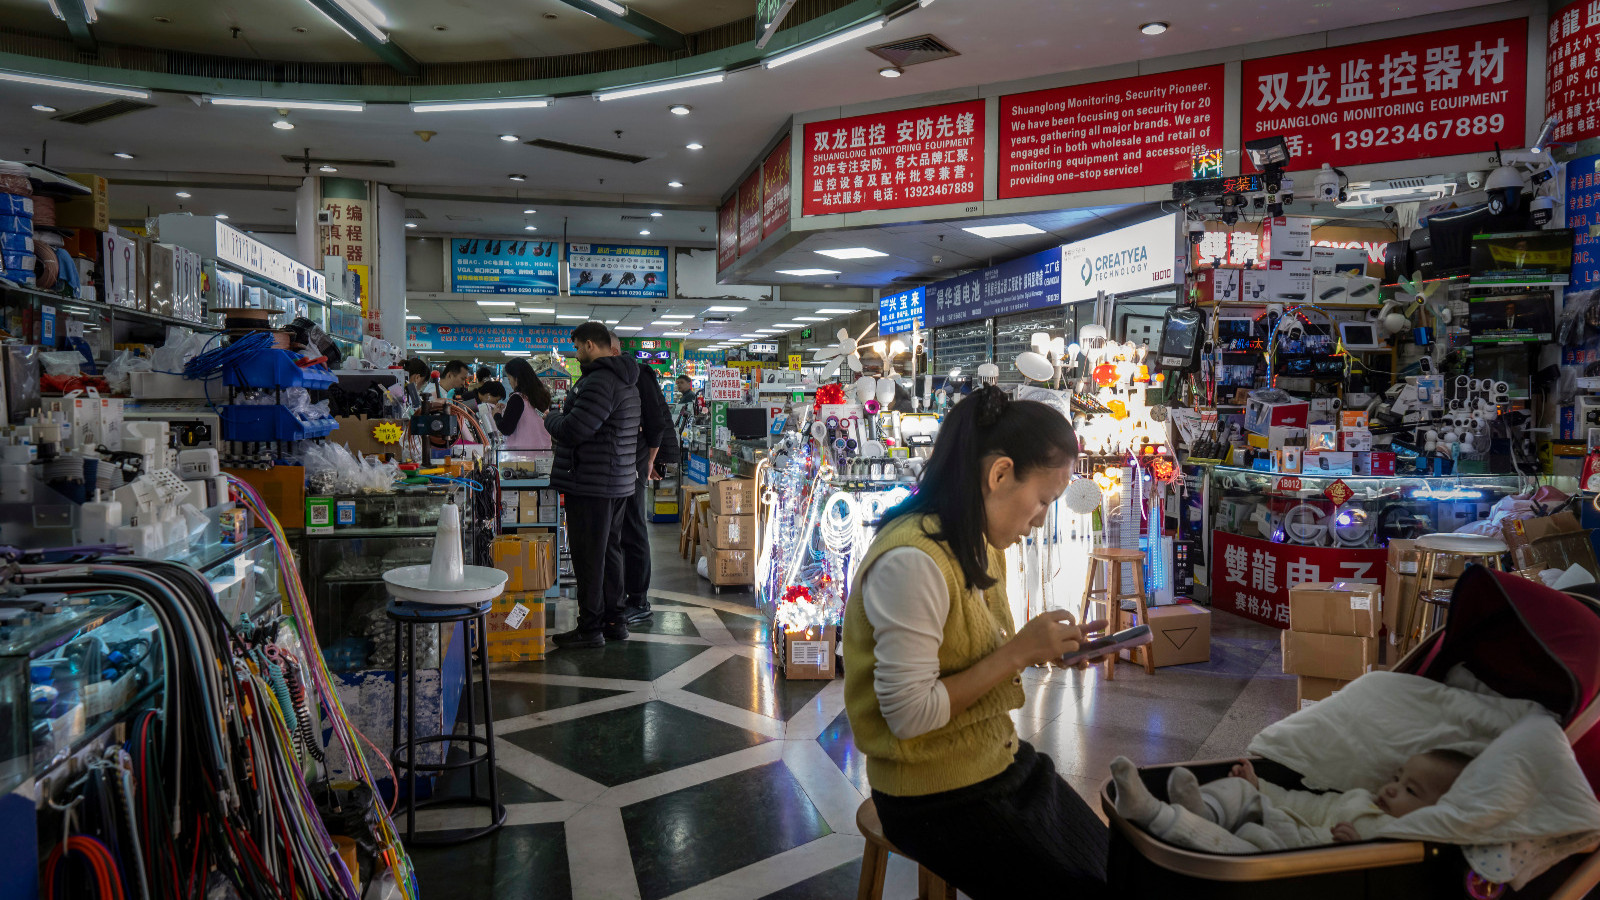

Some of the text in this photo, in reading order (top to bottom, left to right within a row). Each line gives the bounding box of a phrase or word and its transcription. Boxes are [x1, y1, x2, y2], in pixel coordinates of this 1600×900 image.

[1255, 38, 1510, 112] 双龙监控器材
[1566, 72, 1578, 87] IPS
[1585, 66, 1598, 80] 4G
[1011, 82, 1211, 116] Shuanglong Monitoring, Security Pioneer.
[1564, 82, 1600, 104] TP-LI
[1011, 97, 1212, 132] We have been focusing on security for 20
[1255, 90, 1509, 133] SHUANGLONG MONITORING EQUIPMENT
[814, 112, 975, 151] 双龙监控 安防先锋
[1010, 114, 1211, 148] years, gathering all major brands. We are
[1010, 126, 1211, 160] engaged in both wholesale and retail of
[1331, 113, 1505, 151] 13923467889
[814, 136, 974, 162] SHUANGLONG MONITORING EQUIPMENT
[1010, 158, 1062, 173] monitoring
[1066, 152, 1118, 169] equipment
[1122, 148, 1142, 161] and
[1010, 172, 1055, 188] providing
[1103, 163, 1143, 177] service!
[346, 204, 363, 262] 编程器
[1095, 246, 1148, 272] CREATYEA
[1095, 262, 1148, 282] TECHNOLOGY
[1280, 479, 1300, 488] 1B012
[1234, 591, 1290, 624] 赛格分店
